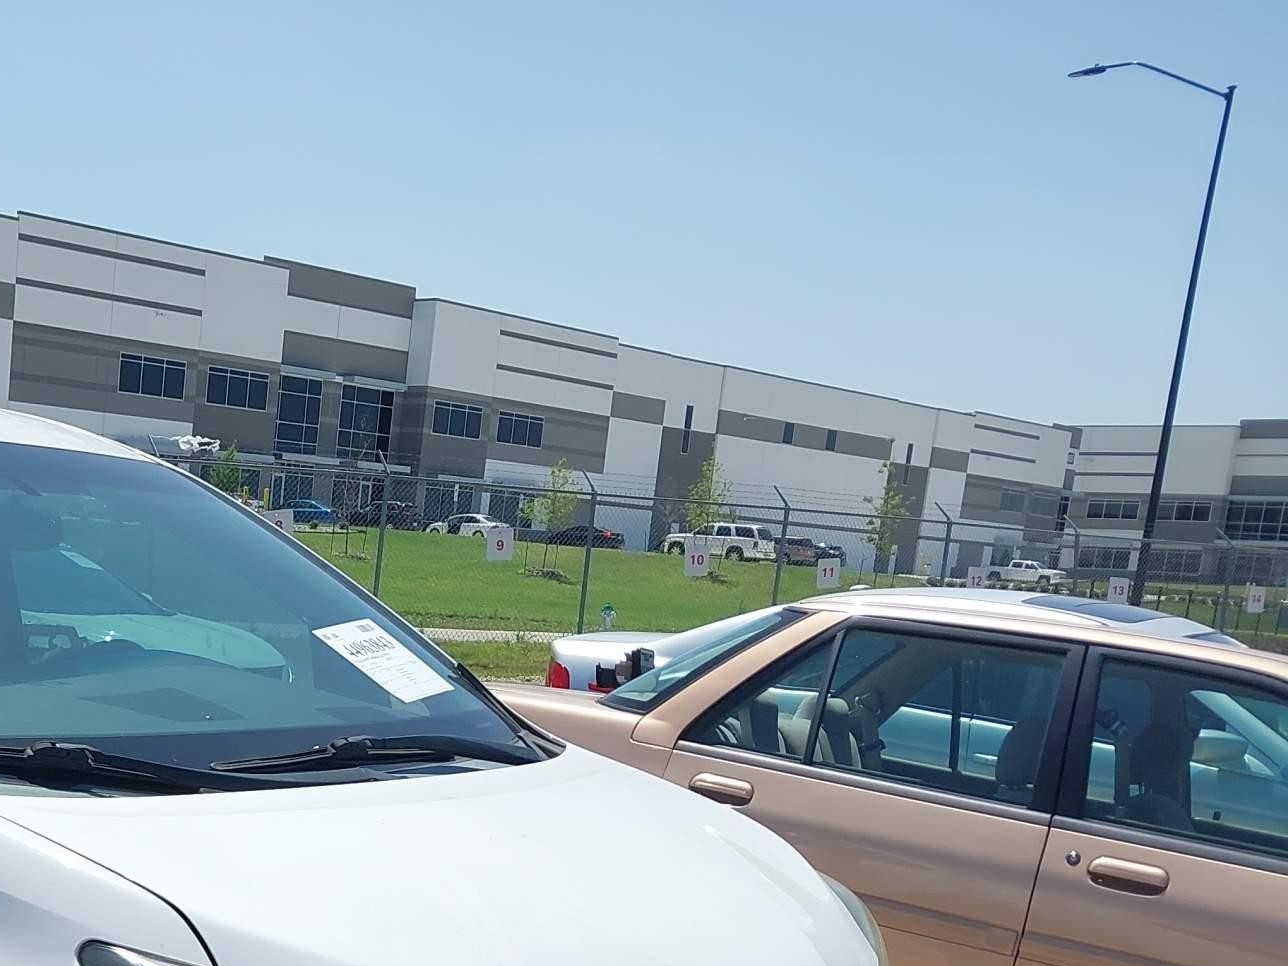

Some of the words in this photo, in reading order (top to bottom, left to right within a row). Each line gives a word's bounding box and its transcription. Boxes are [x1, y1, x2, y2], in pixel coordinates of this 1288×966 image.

[496, 539, 505, 551] 9
[690, 554, 704, 566] 10
[822, 567, 834, 578] 11
[971, 576, 982, 586] 12
[1112, 585, 1125, 596] 13
